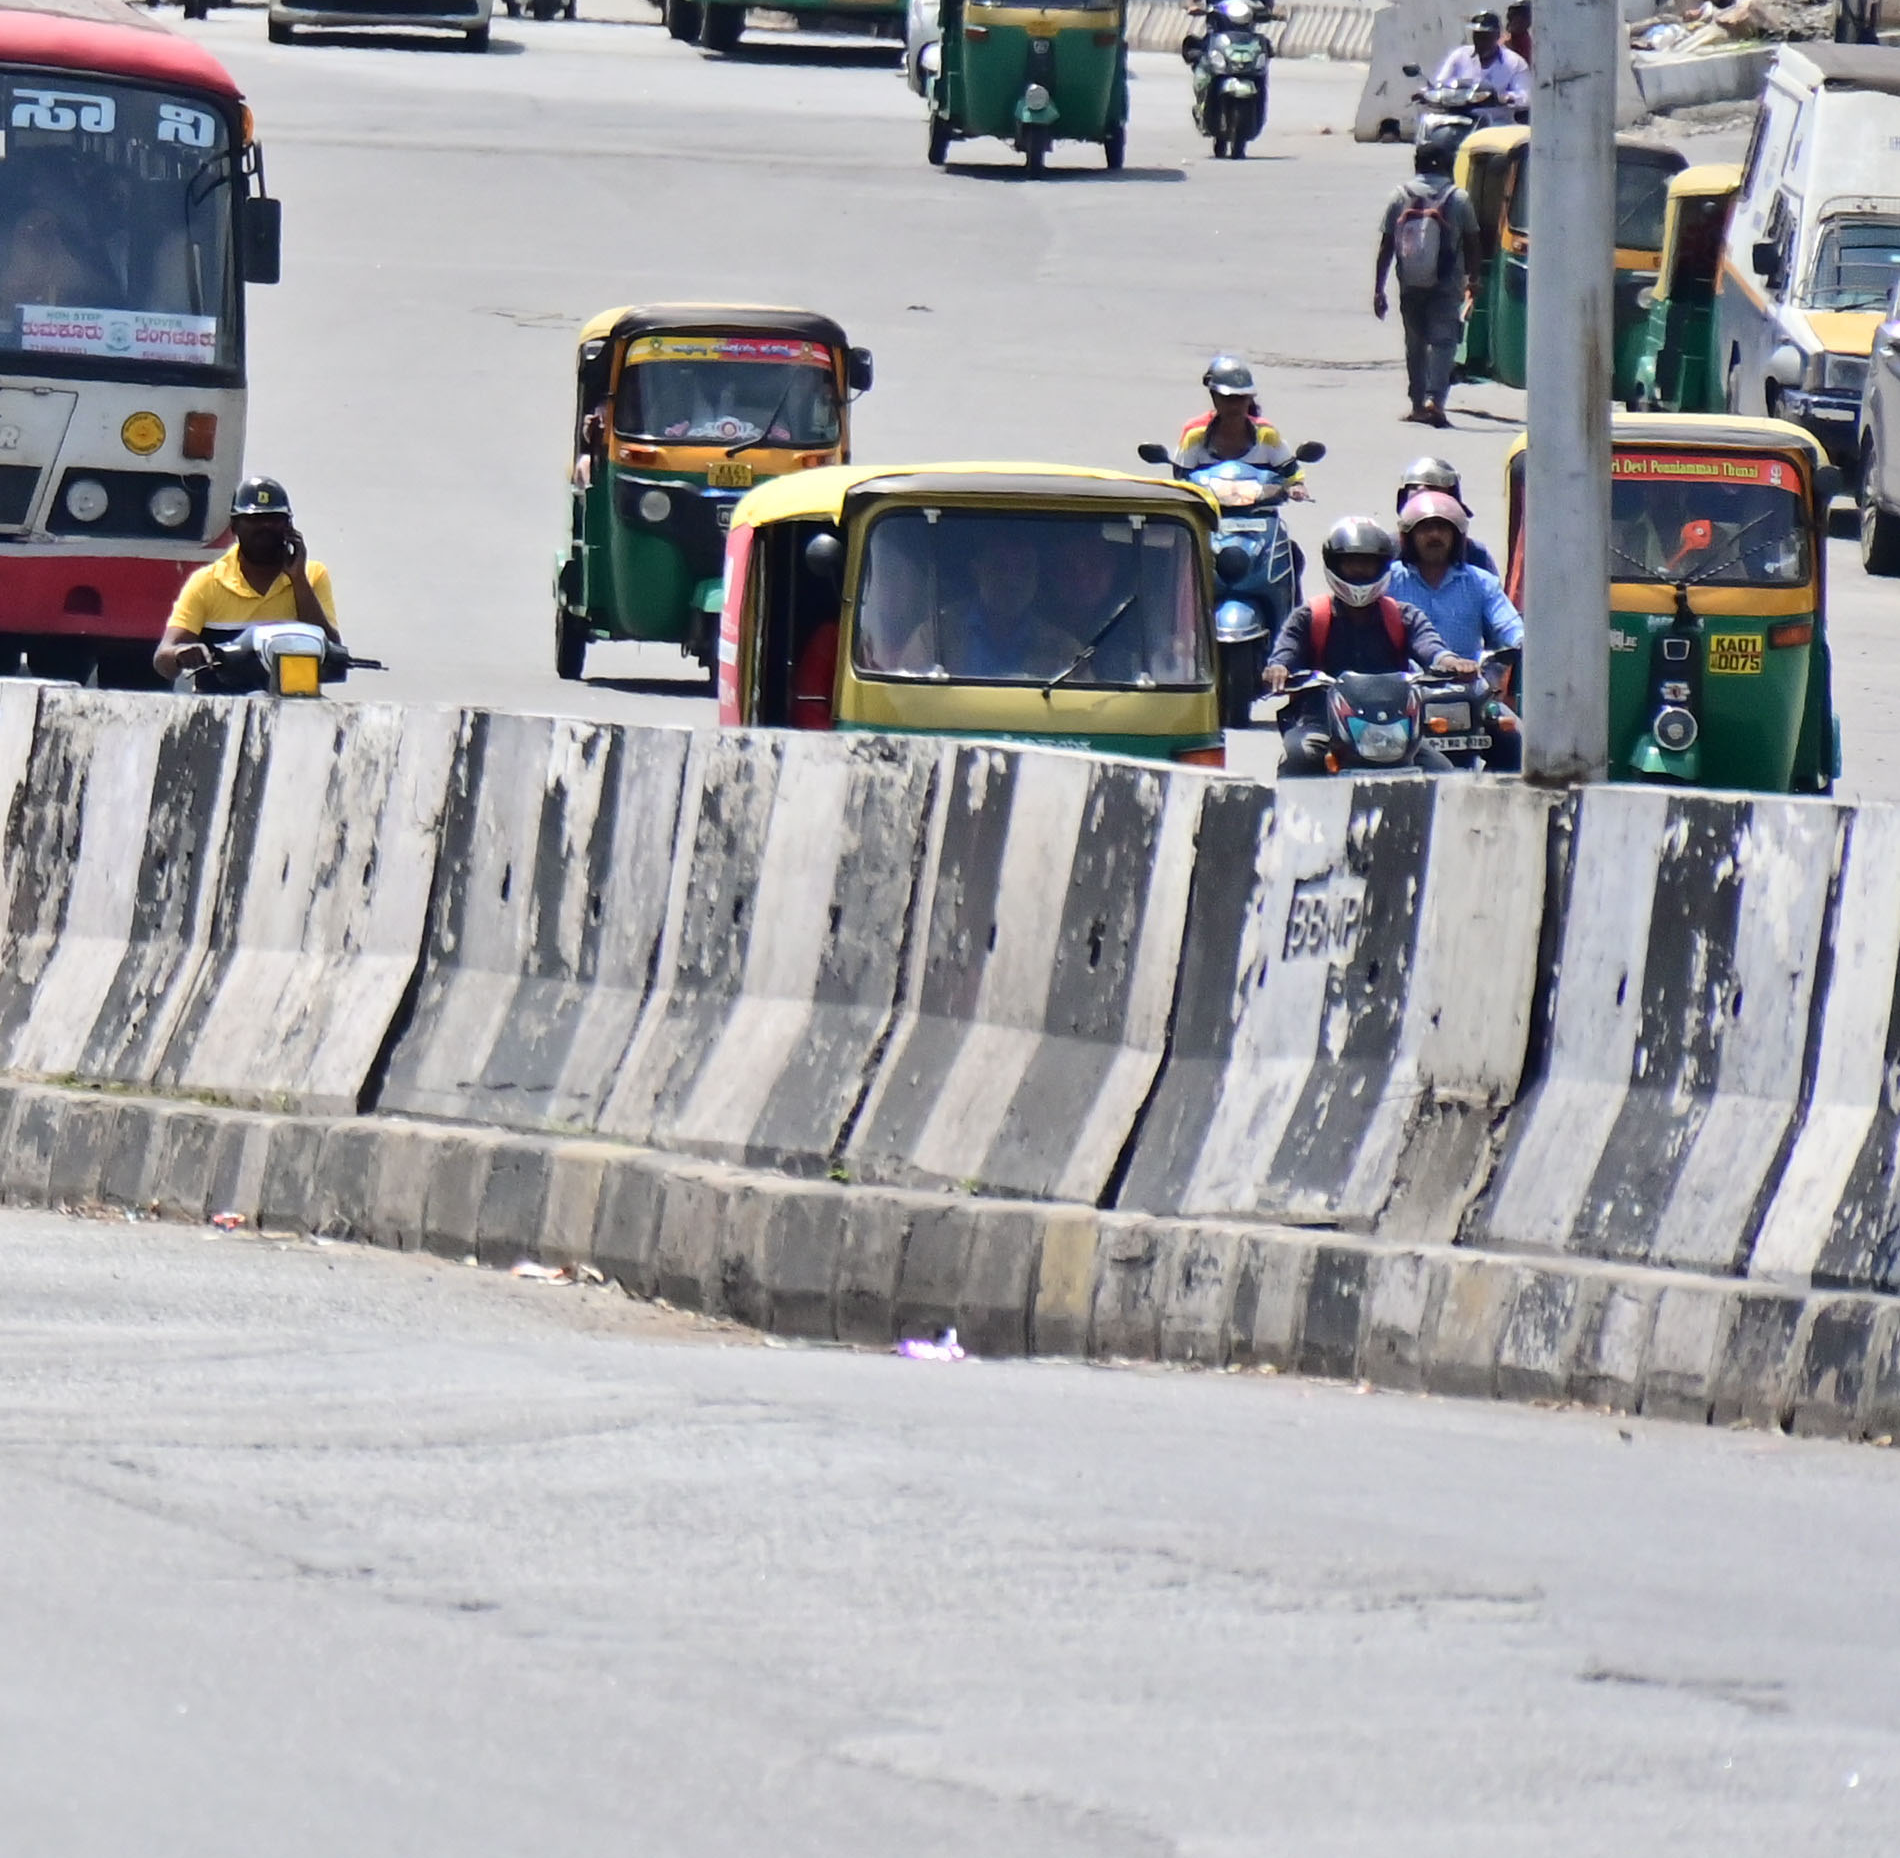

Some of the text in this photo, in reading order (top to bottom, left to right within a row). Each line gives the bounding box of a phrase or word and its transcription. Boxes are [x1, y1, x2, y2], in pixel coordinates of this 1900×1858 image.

[1623, 459, 1647, 474] Devi
[1722, 461, 1759, 478] Thunai
[1716, 637, 1759, 653] KA01
